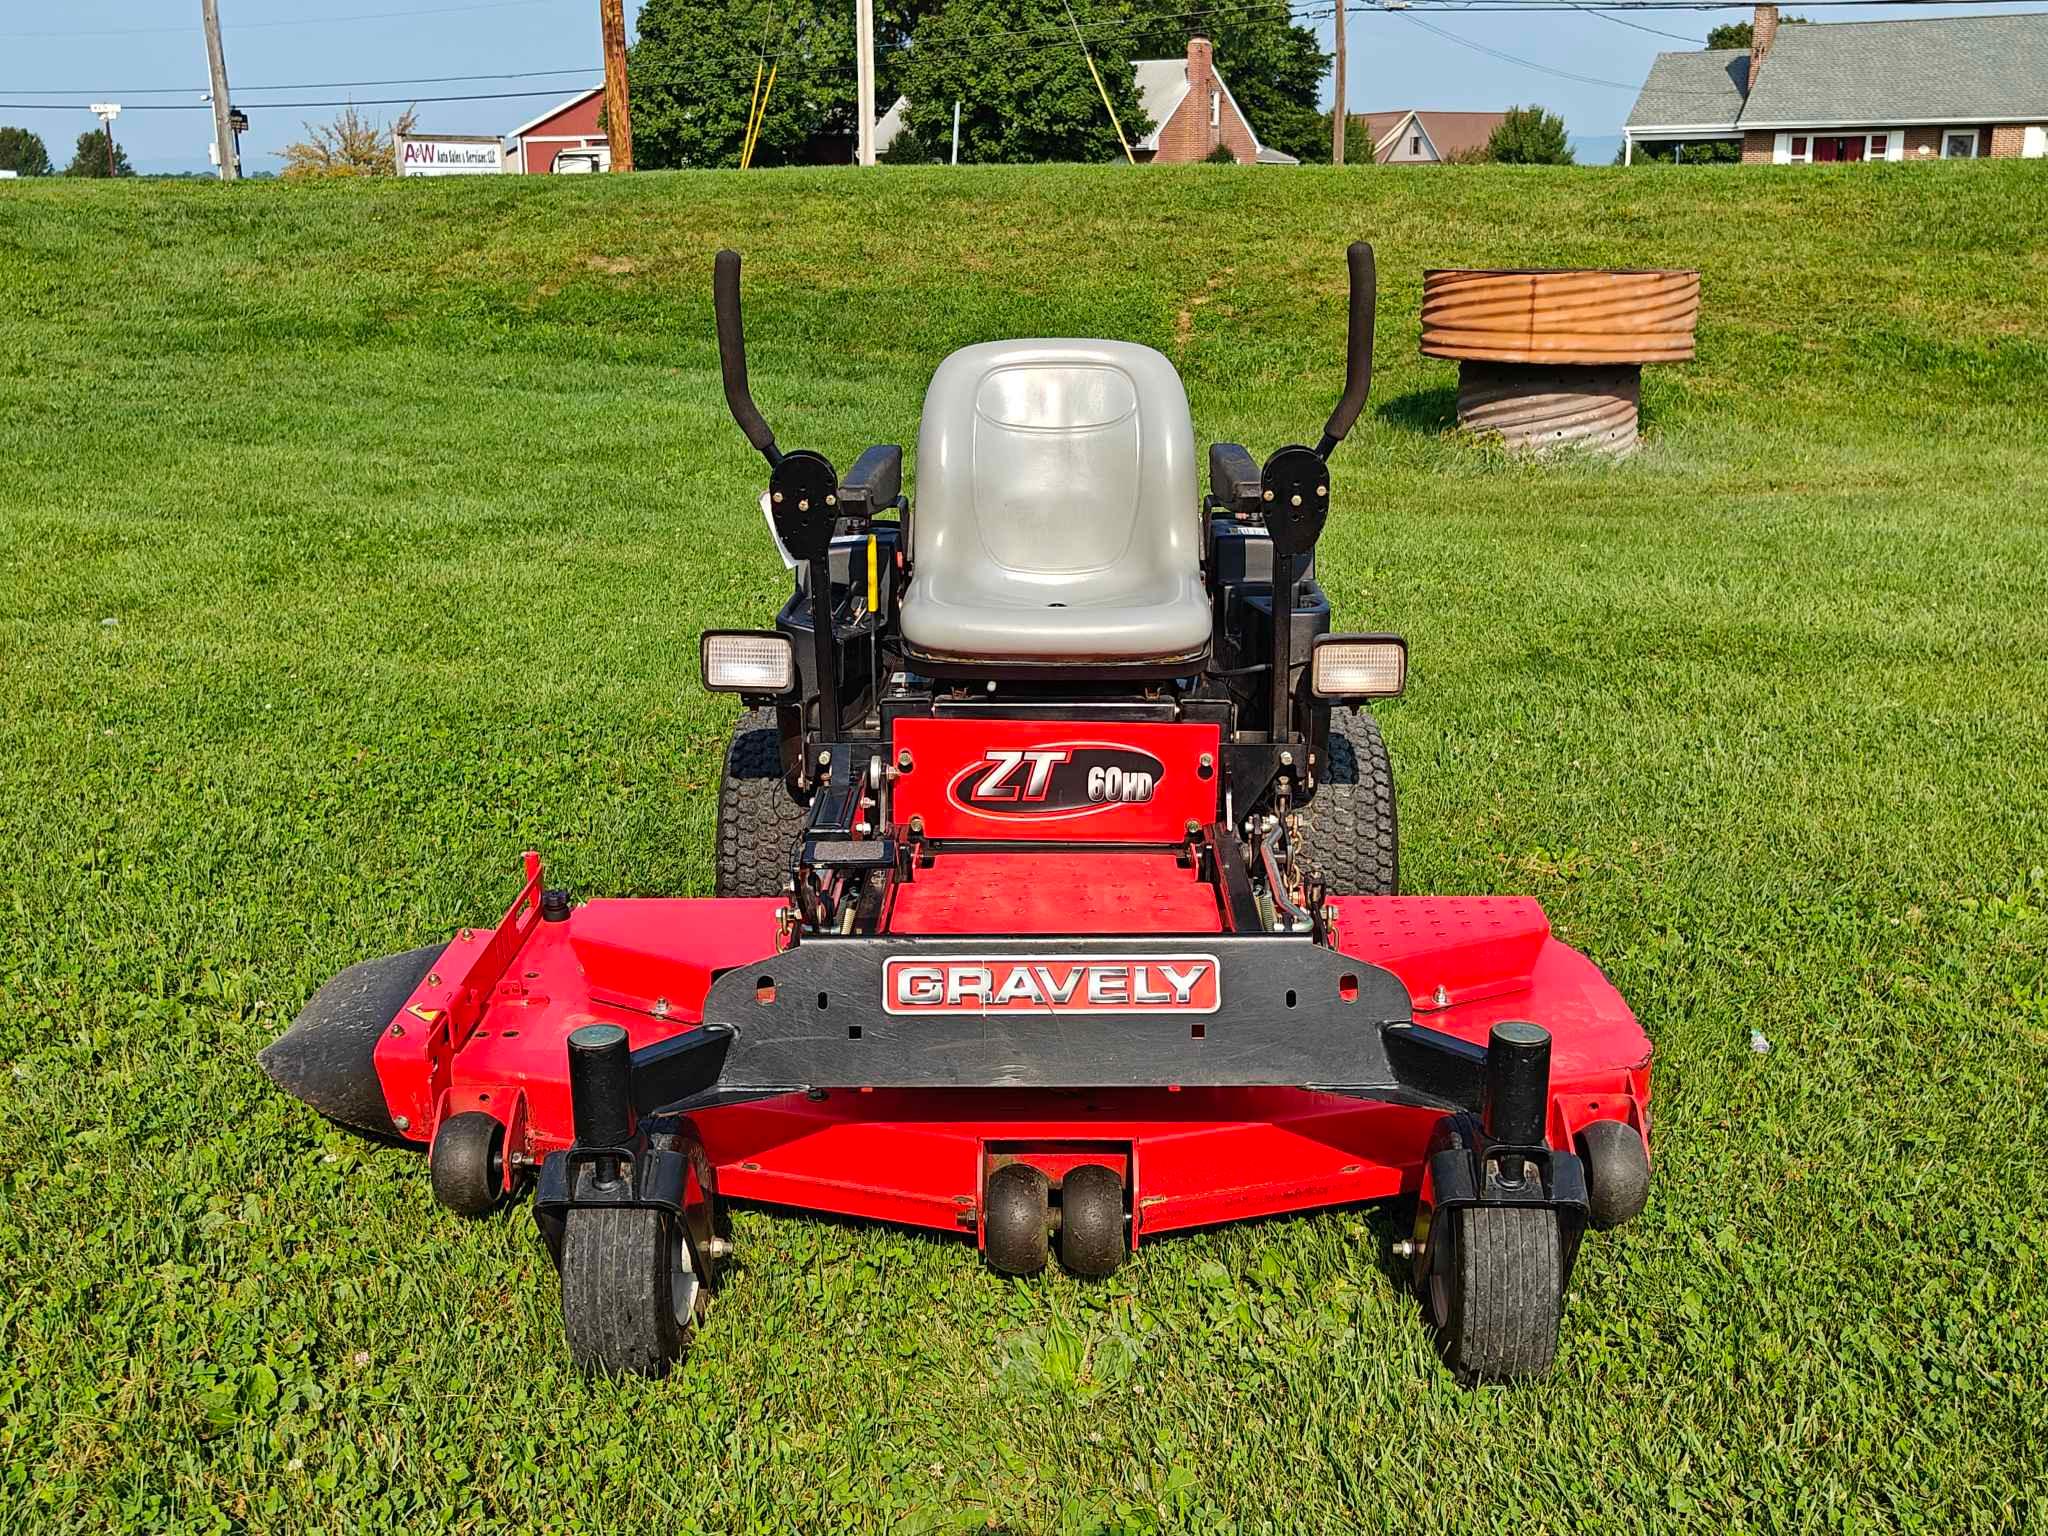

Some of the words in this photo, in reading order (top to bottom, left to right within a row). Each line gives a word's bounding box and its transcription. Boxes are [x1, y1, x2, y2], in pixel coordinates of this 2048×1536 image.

[404, 143, 435, 163] A&W
[973, 750, 1070, 799] ZT
[1088, 767, 1154, 801] 60HD
[898, 966, 1209, 1005] GRAVELY
